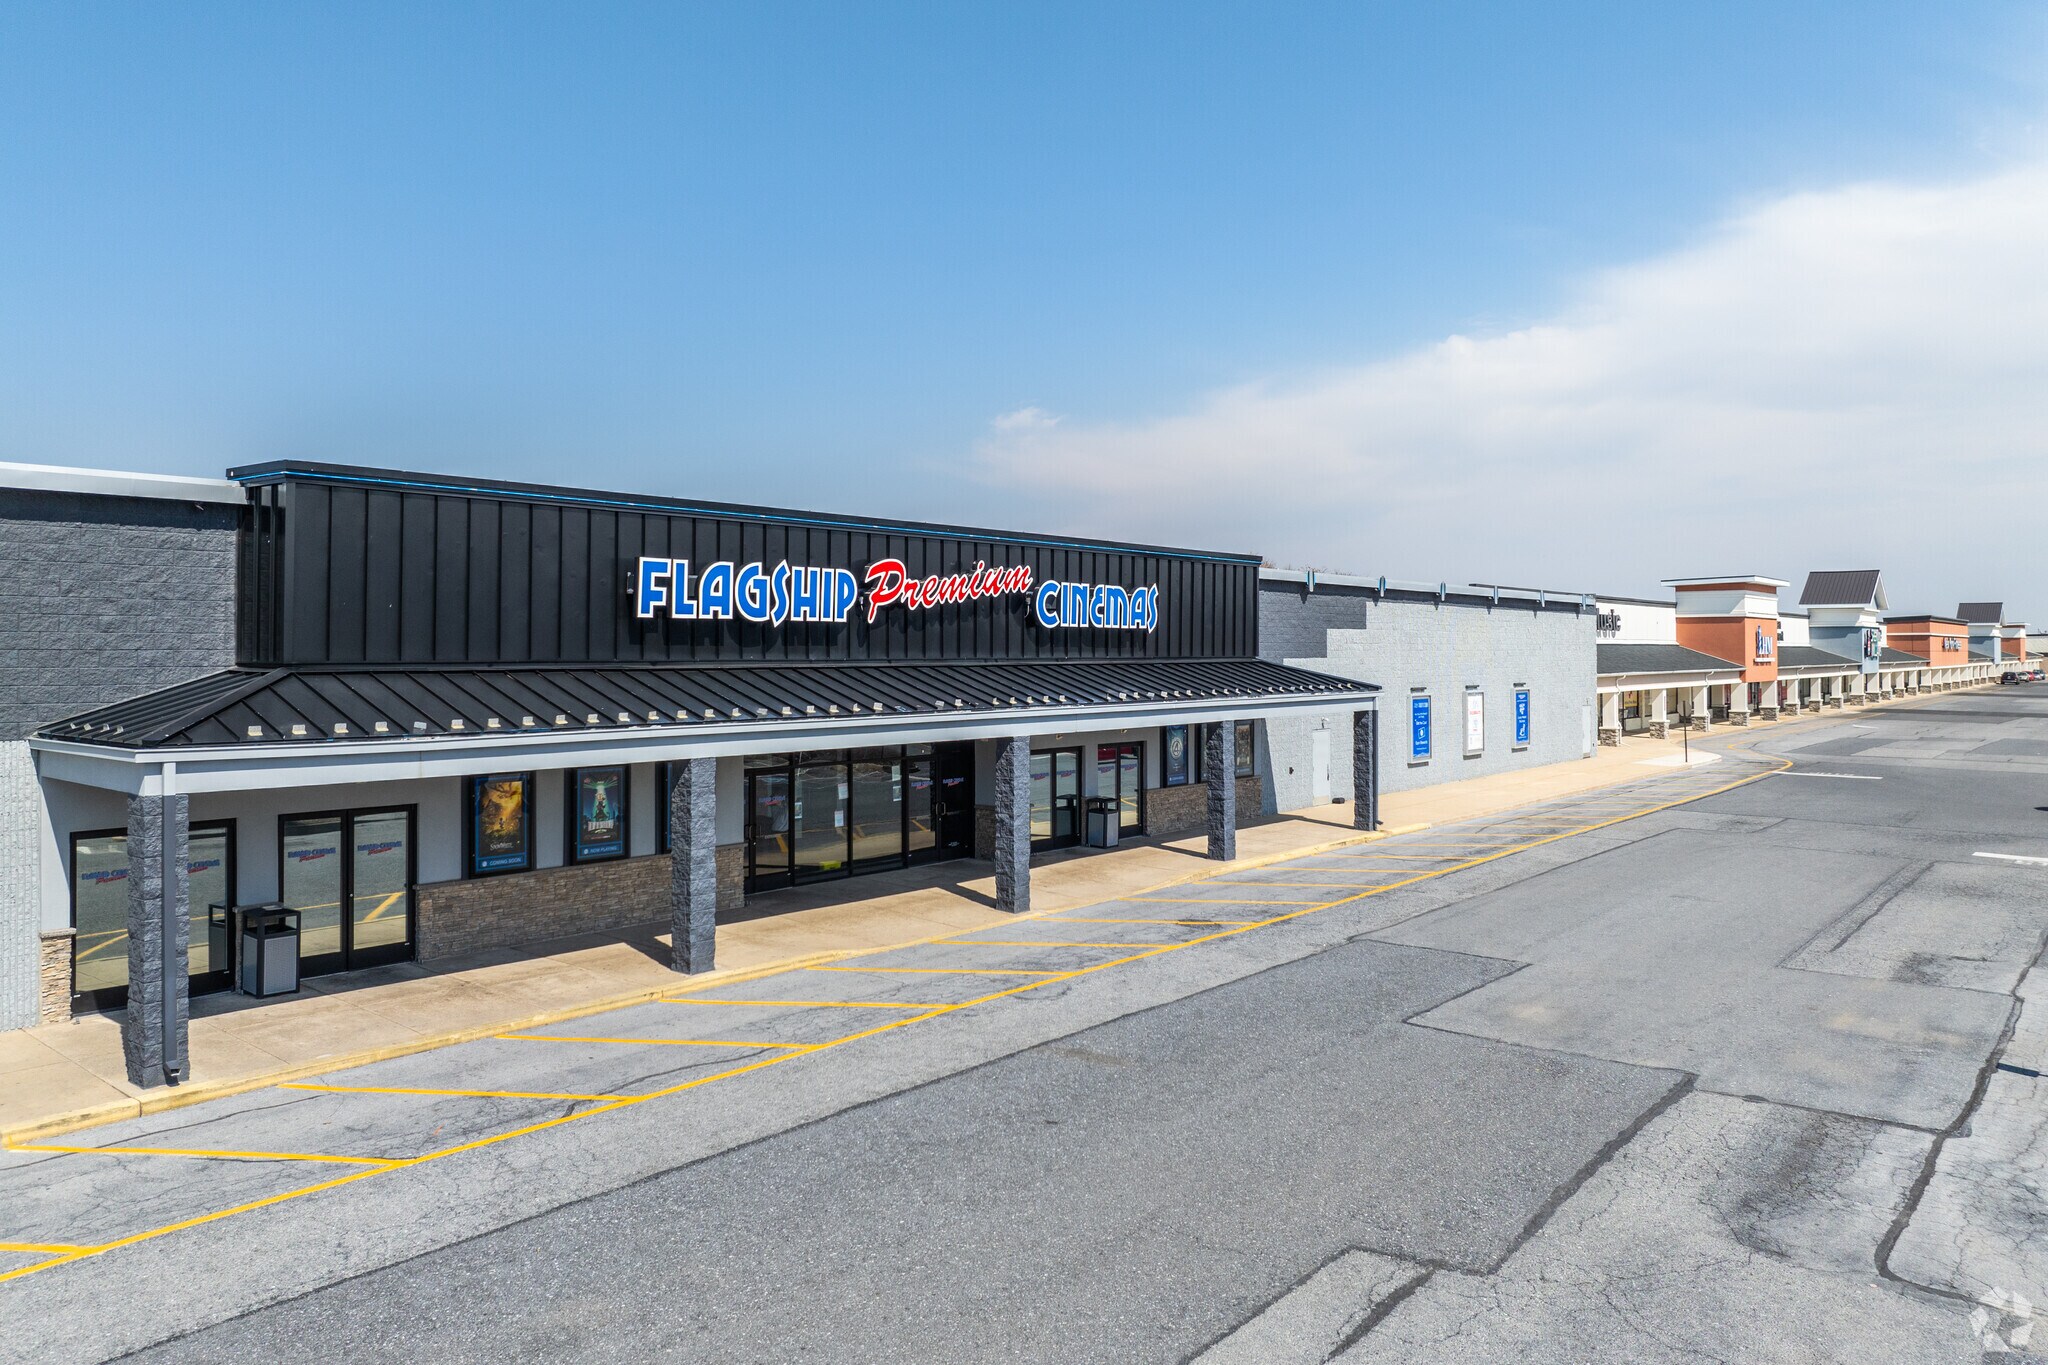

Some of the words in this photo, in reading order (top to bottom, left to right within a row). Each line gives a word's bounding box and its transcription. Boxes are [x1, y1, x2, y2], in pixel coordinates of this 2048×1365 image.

[636, 556, 857, 627] FLAGSHIP
[864, 558, 1032, 625] Premium
[1036, 580, 1159, 634] CINEMAS
[489, 858, 508, 866] COMING
[508, 856, 522, 864] SOON
